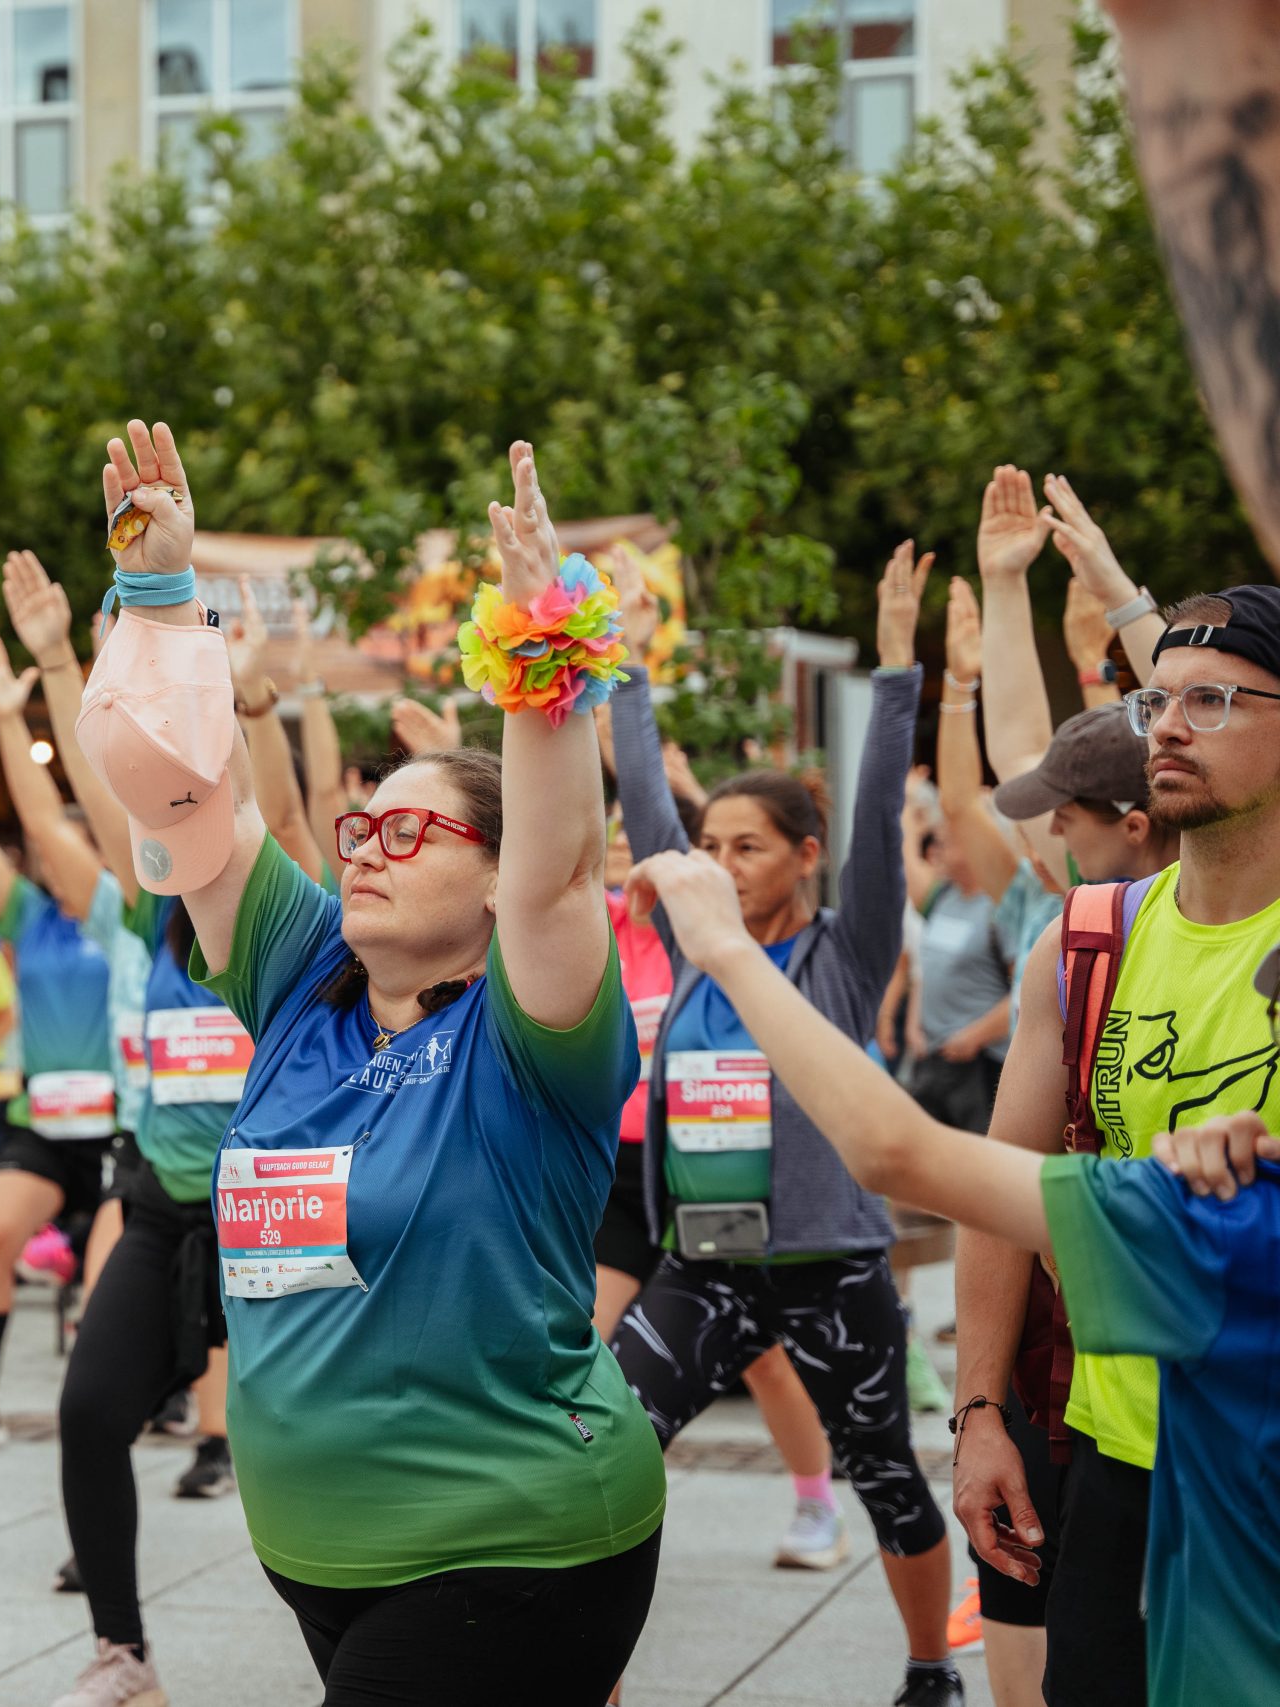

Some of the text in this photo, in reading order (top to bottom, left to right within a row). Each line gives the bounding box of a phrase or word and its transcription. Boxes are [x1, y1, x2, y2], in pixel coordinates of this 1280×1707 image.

[682, 1079, 769, 1104] Simone
[218, 1188, 324, 1229] Marjorie
[260, 1229, 282, 1245] 529
